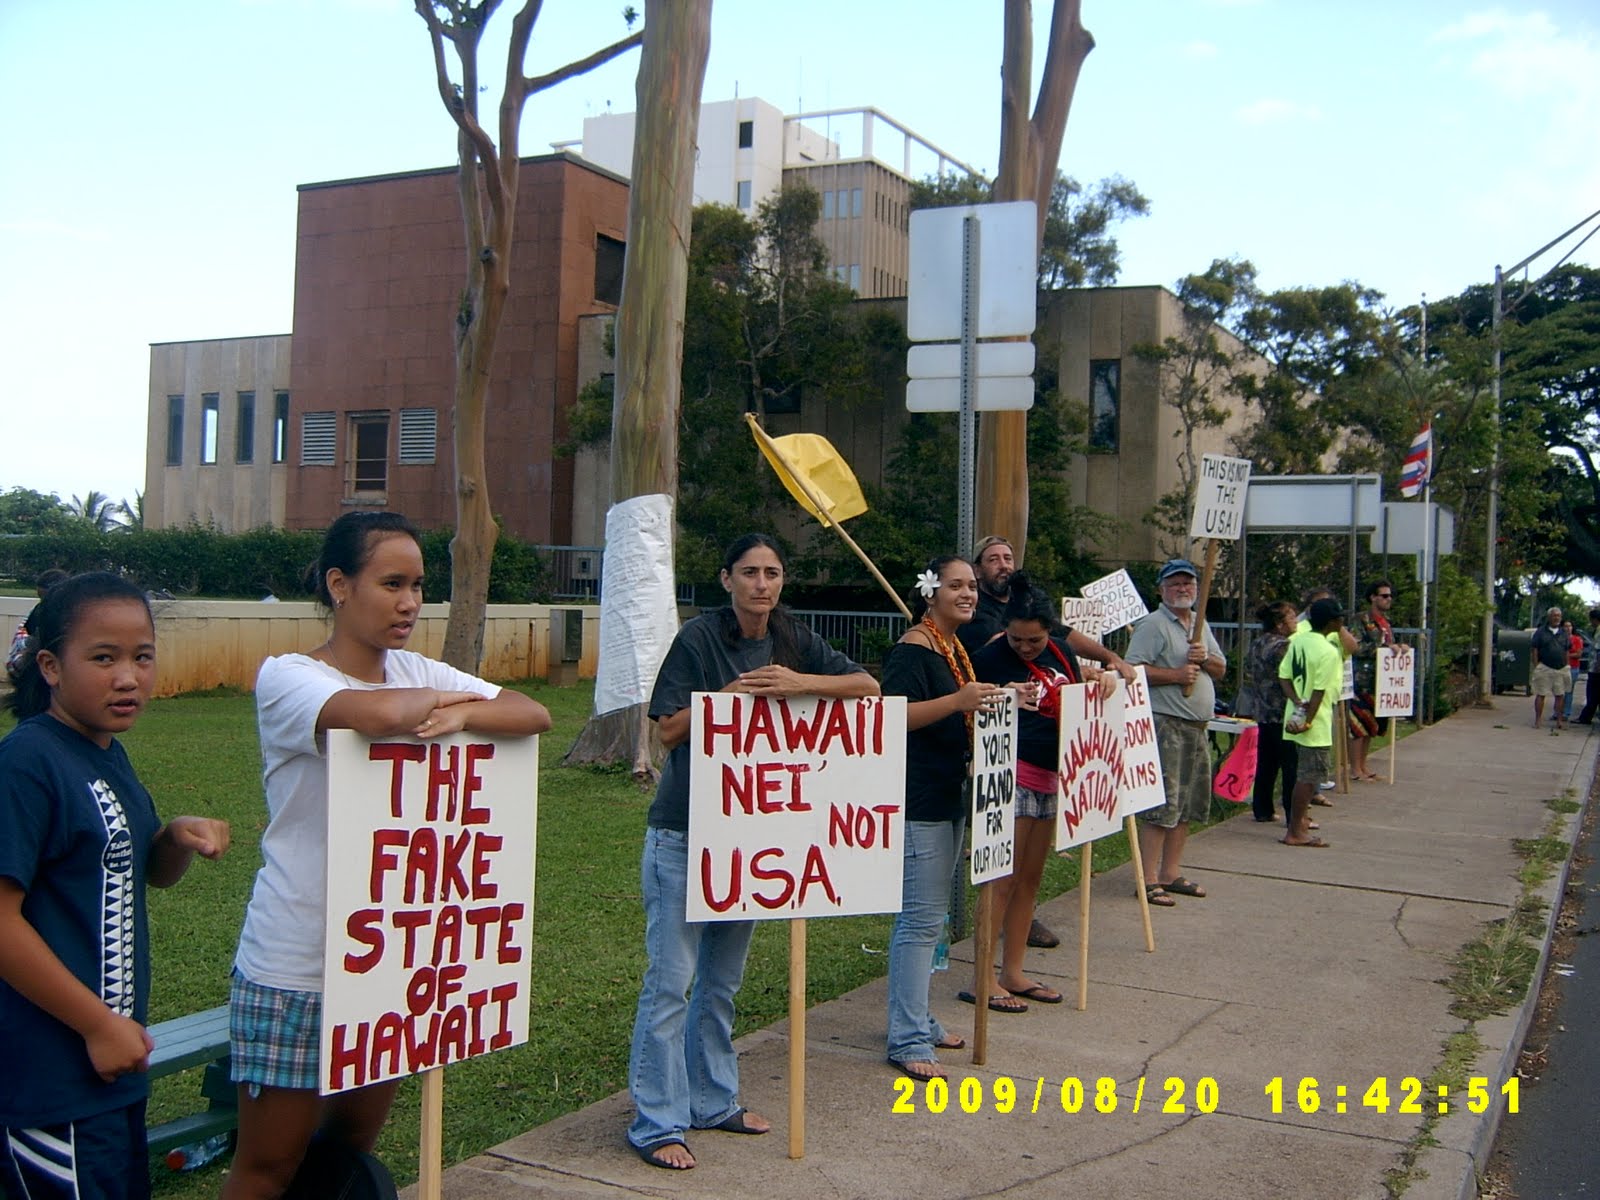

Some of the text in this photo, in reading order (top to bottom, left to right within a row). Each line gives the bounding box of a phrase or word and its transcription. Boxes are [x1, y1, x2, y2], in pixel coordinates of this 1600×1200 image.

[1203, 457, 1227, 480] THIS
[1227, 462, 1236, 482] IS
[1217, 485, 1237, 504] THE
[1084, 573, 1126, 598] CEDED
[1101, 613, 1121, 632] SAY
[1384, 655, 1411, 671] STOP
[1389, 677, 1404, 687] THE
[1380, 692, 1411, 709] FRAUD
[982, 732, 1011, 767] YOUR
[1059, 719, 1125, 797] HAWAIIAN
[369, 743, 495, 826] THE
[976, 768, 1013, 813] LAND
[1064, 770, 1118, 839] NATION
[828, 802, 900, 849] NOT
[985, 809, 1003, 836] FOR
[370, 827, 503, 903] FAKE
[974, 839, 1012, 875] OUR KIDS
[701, 844, 841, 913] U.S.A.
[343, 903, 525, 974] STATE
[406, 964, 467, 1016] OF
[329, 982, 518, 1089] HAWAII
